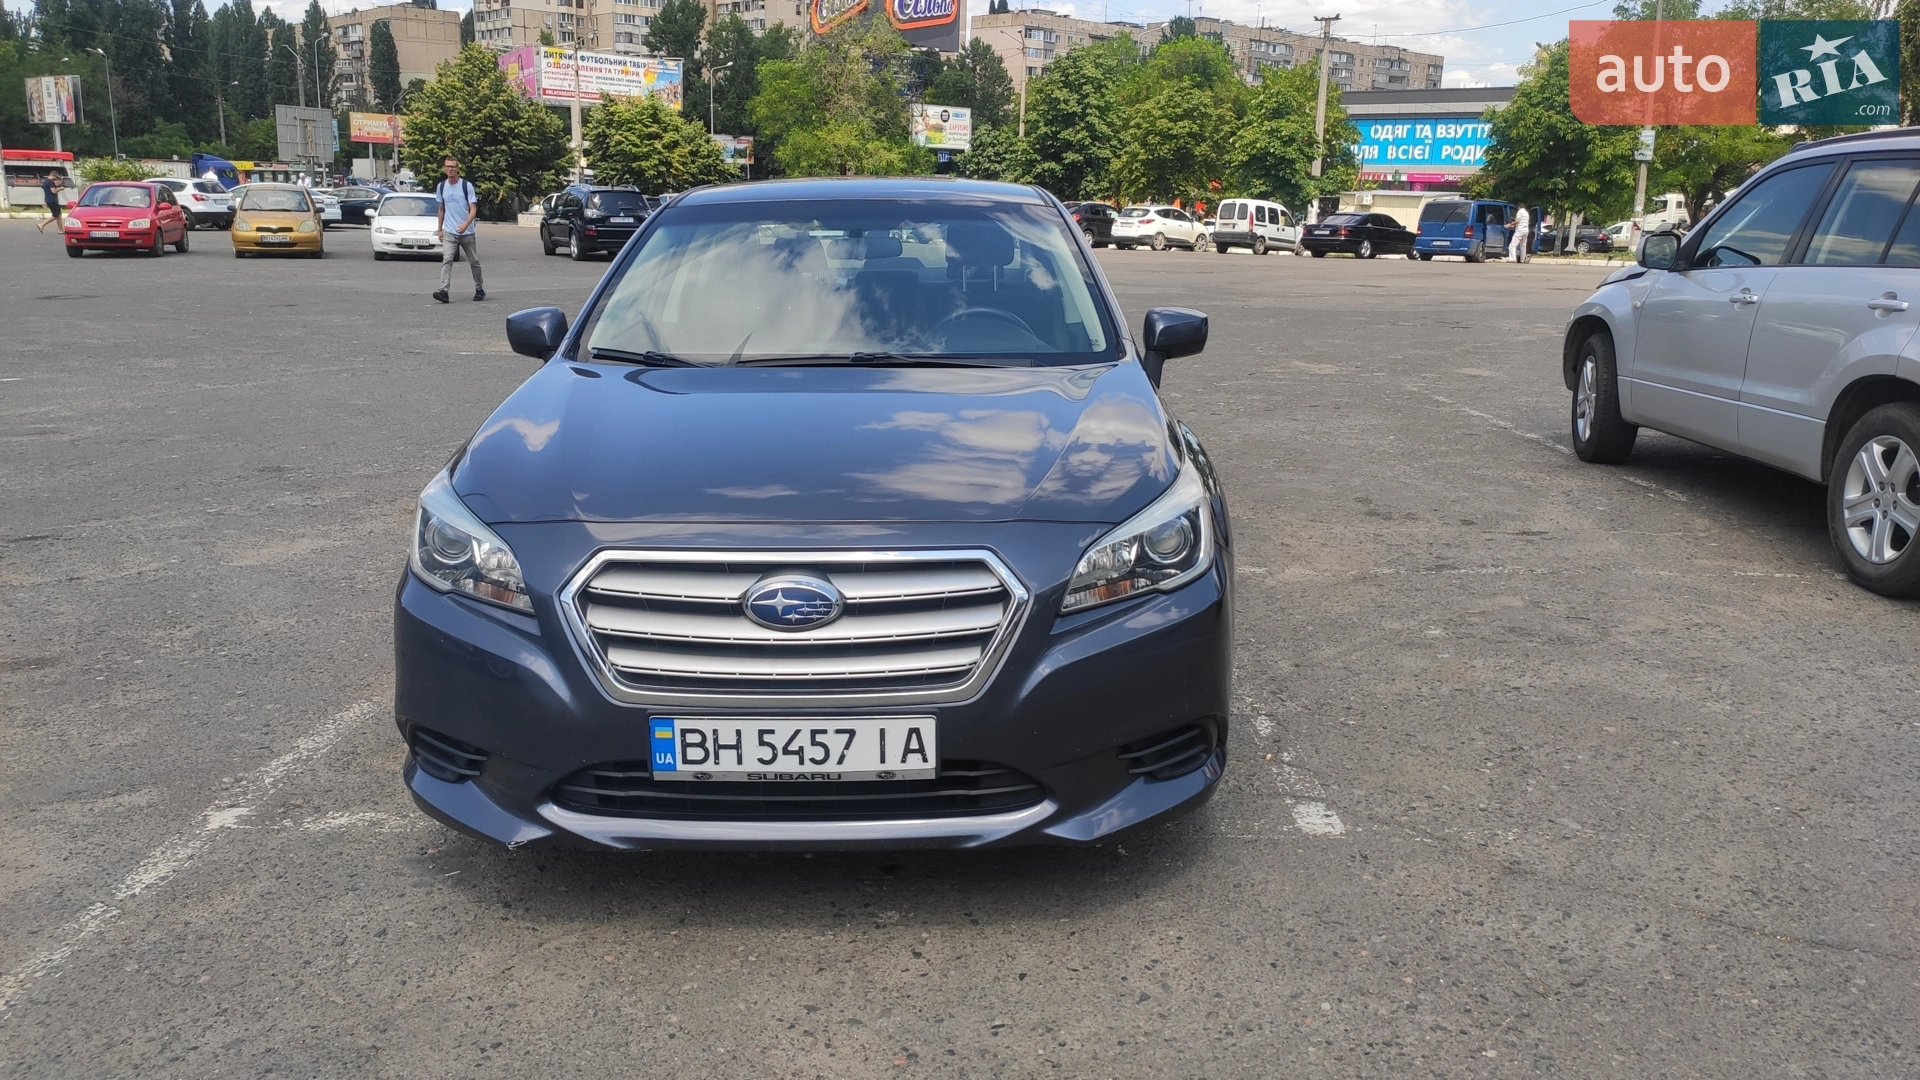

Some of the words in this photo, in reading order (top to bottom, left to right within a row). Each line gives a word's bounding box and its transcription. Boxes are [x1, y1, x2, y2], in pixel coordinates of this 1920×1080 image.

[543, 50, 575, 62] ДИТЯЧИ
[580, 54, 628, 67] ФУТБОЛЬНИЙ
[629, 60, 647, 69] ТАБІР
[604, 67, 612, 75] ТА
[613, 68, 640, 78] ТУРНІРИ
[353, 118, 389, 127] ОТРИМУЙ
[1370, 124, 1412, 142] ОДЯГ
[1415, 124, 1432, 139] ТА
[1386, 139, 1432, 160] ВСІЄЇ
[679, 727, 743, 766] BH
[756, 728, 857, 766] 5457
[879, 727, 929, 764] IA
[655, 752, 674, 765] UA
[747, 772, 842, 781] SUBARU
